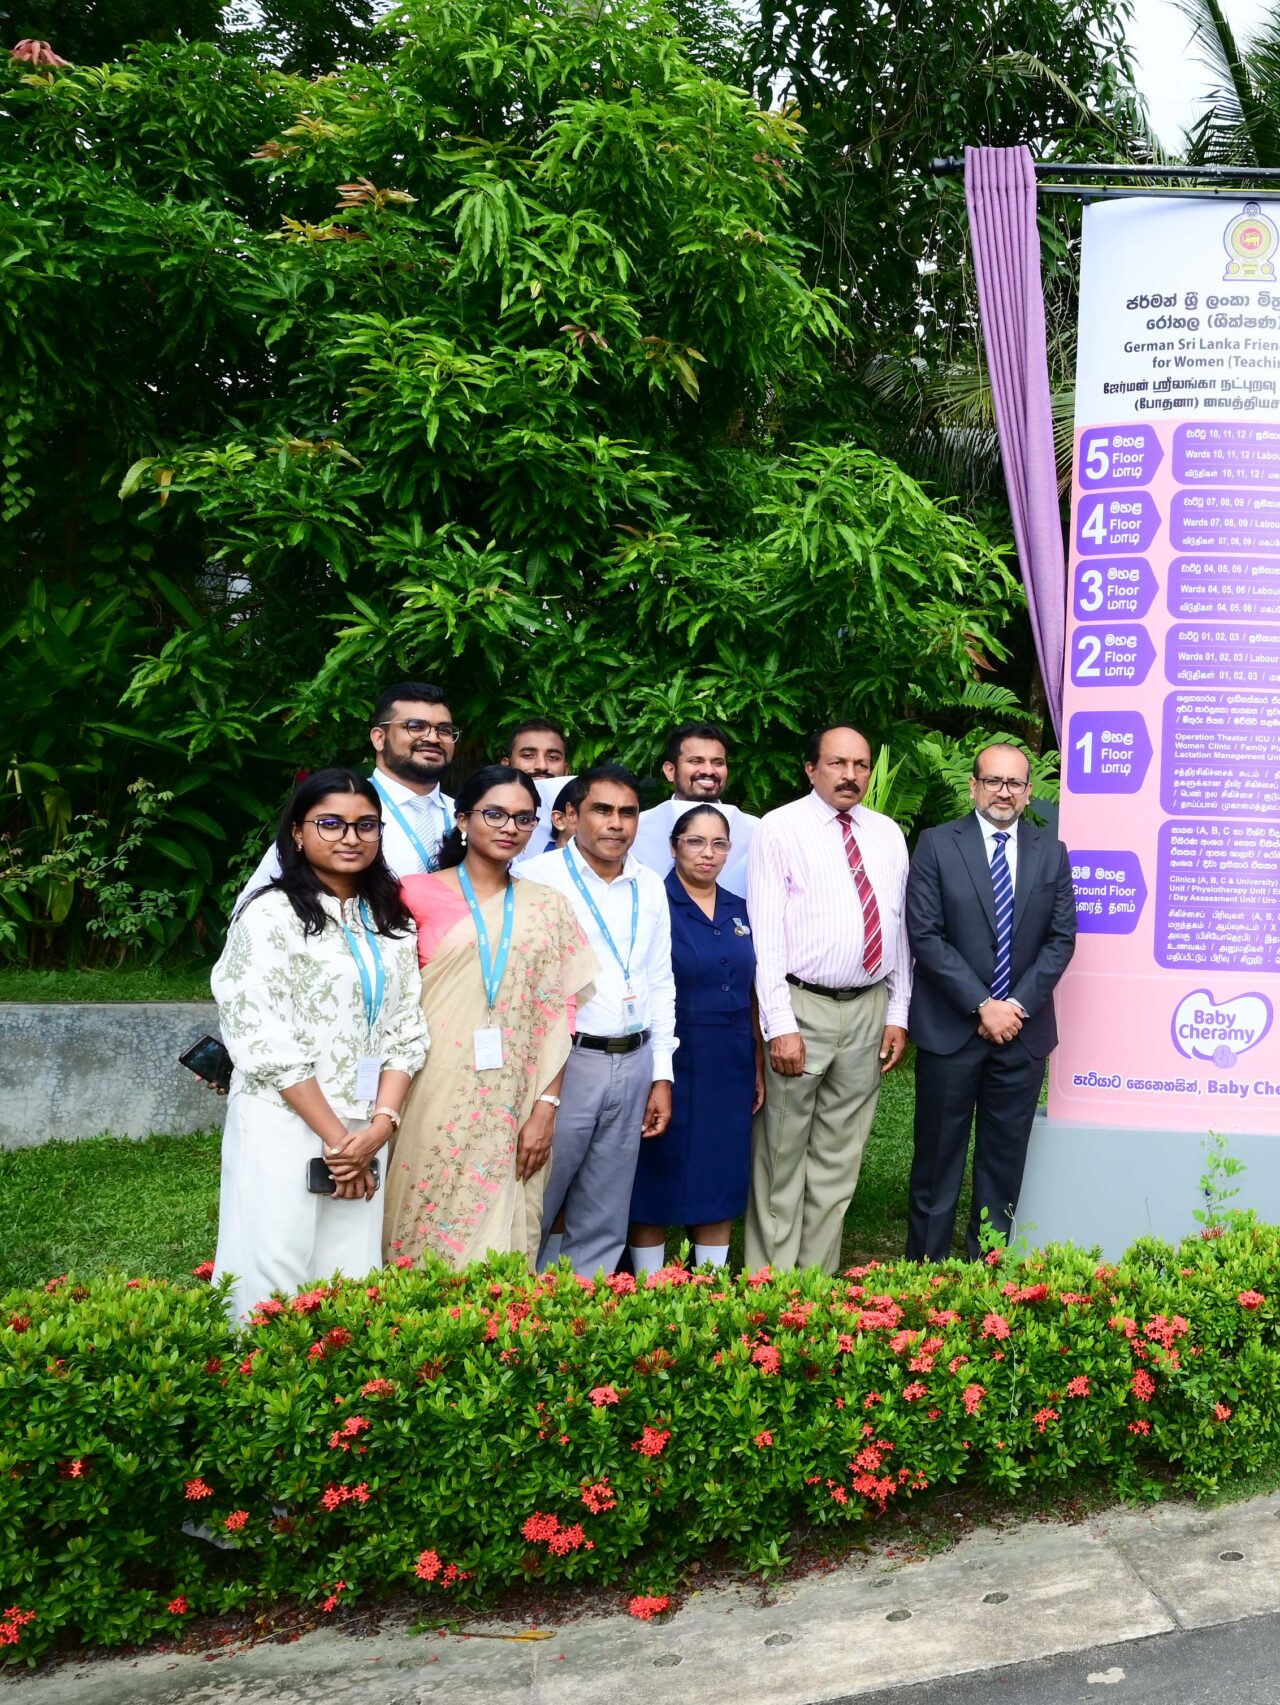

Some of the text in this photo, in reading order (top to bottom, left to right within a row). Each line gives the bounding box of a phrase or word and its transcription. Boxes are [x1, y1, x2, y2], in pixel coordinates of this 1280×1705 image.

[1206, 295, 1250, 309] ලංකා
[1146, 315, 1200, 331] රෝහල
[1124, 341, 1174, 353] German
[1178, 338, 1196, 350] Sri
[1199, 337, 1240, 350] Lanka
[1152, 356, 1172, 368] for
[1174, 356, 1224, 368] Women
[1085, 438, 1109, 480] 5
[1112, 452, 1144, 465] Floor
[1185, 450, 1211, 459] Wards
[1213, 450, 1225, 460] 10,
[1227, 450, 1239, 460] 11,
[1241, 450, 1250, 459] 12
[1112, 466, 1142, 480] மாடி
[1081, 503, 1107, 545] 4
[1110, 519, 1142, 531] Floor
[1183, 518, 1208, 527] Wards
[1110, 533, 1140, 546] மாடி
[1079, 569, 1104, 612] 3
[1107, 585, 1139, 597] Floor
[1180, 584, 1206, 594] Wards
[1252, 586, 1280, 596] Labour
[1107, 599, 1138, 613] மாடி
[1075, 635, 1102, 678] 2
[1105, 651, 1137, 663] Floor
[1178, 652, 1203, 661] Wards
[1205, 652, 1217, 662] 01,
[1219, 652, 1231, 662] 02,
[1233, 653, 1243, 662] 03
[1250, 653, 1279, 663] Labour
[1104, 665, 1135, 679] மாடி
[1175, 733, 1214, 742] Operation
[1217, 734, 1248, 742] Theater
[1075, 731, 1093, 774] 1
[1101, 748, 1134, 760] Floor
[1240, 744, 1267, 753] Family
[1214, 752, 1265, 761] Management
[1101, 763, 1132, 776] மாடி
[1236, 877, 1278, 887] University)
[1109, 885, 1136, 896] Floor
[1169, 884, 1186, 892] Unit
[1191, 885, 1248, 895] Physiotherapy
[1249, 887, 1265, 895] Unit
[1173, 894, 1188, 902] Day
[1190, 894, 1238, 902] Assessment
[1262, 896, 1276, 904] Uro
[1108, 900, 1136, 915] தளம்
[1194, 1010, 1236, 1028] Baby
[1179, 1024, 1255, 1044] Cheramy
[1073, 1072, 1121, 1088] පැටියාට
[1207, 1080, 1249, 1098] Baby
